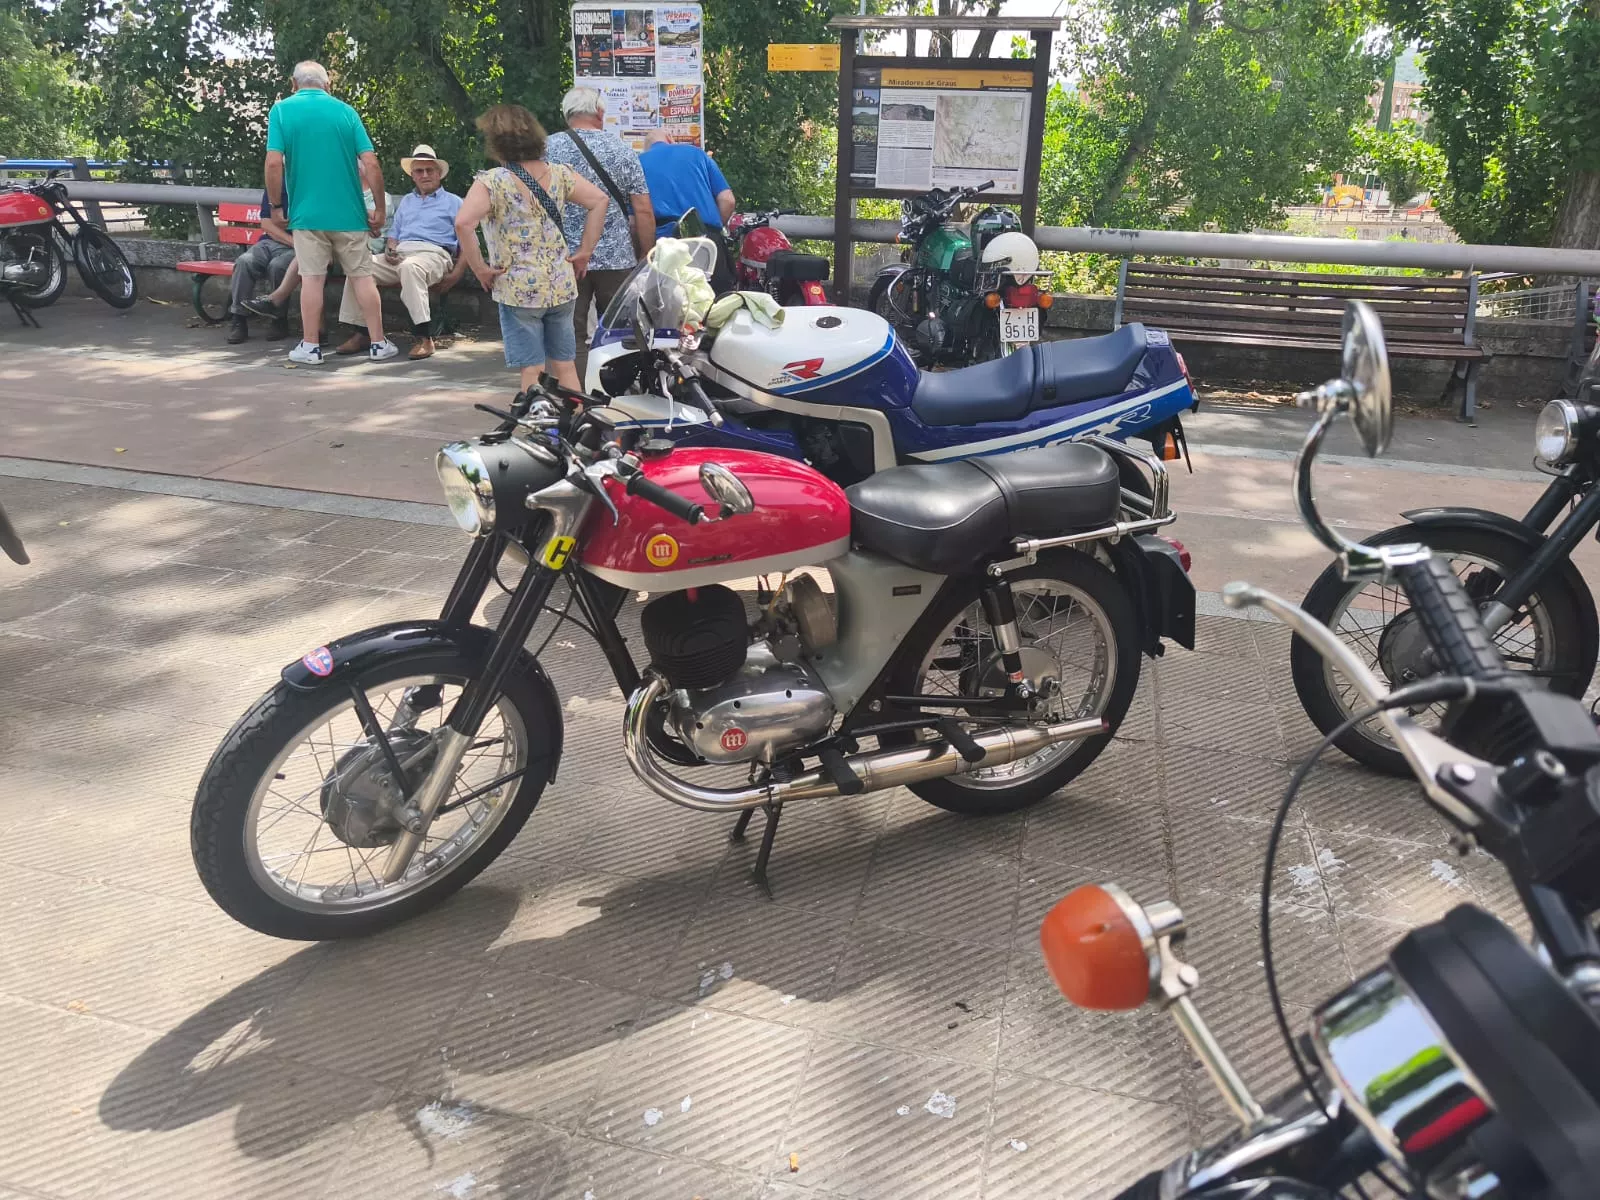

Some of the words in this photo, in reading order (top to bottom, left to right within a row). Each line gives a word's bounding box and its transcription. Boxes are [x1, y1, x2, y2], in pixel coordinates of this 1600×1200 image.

[575, 12, 611, 24] GARNACHA
[575, 24, 594, 35] ROCK
[668, 88, 694, 97] DOMINGO
[1005, 324, 1035, 338] 9516
